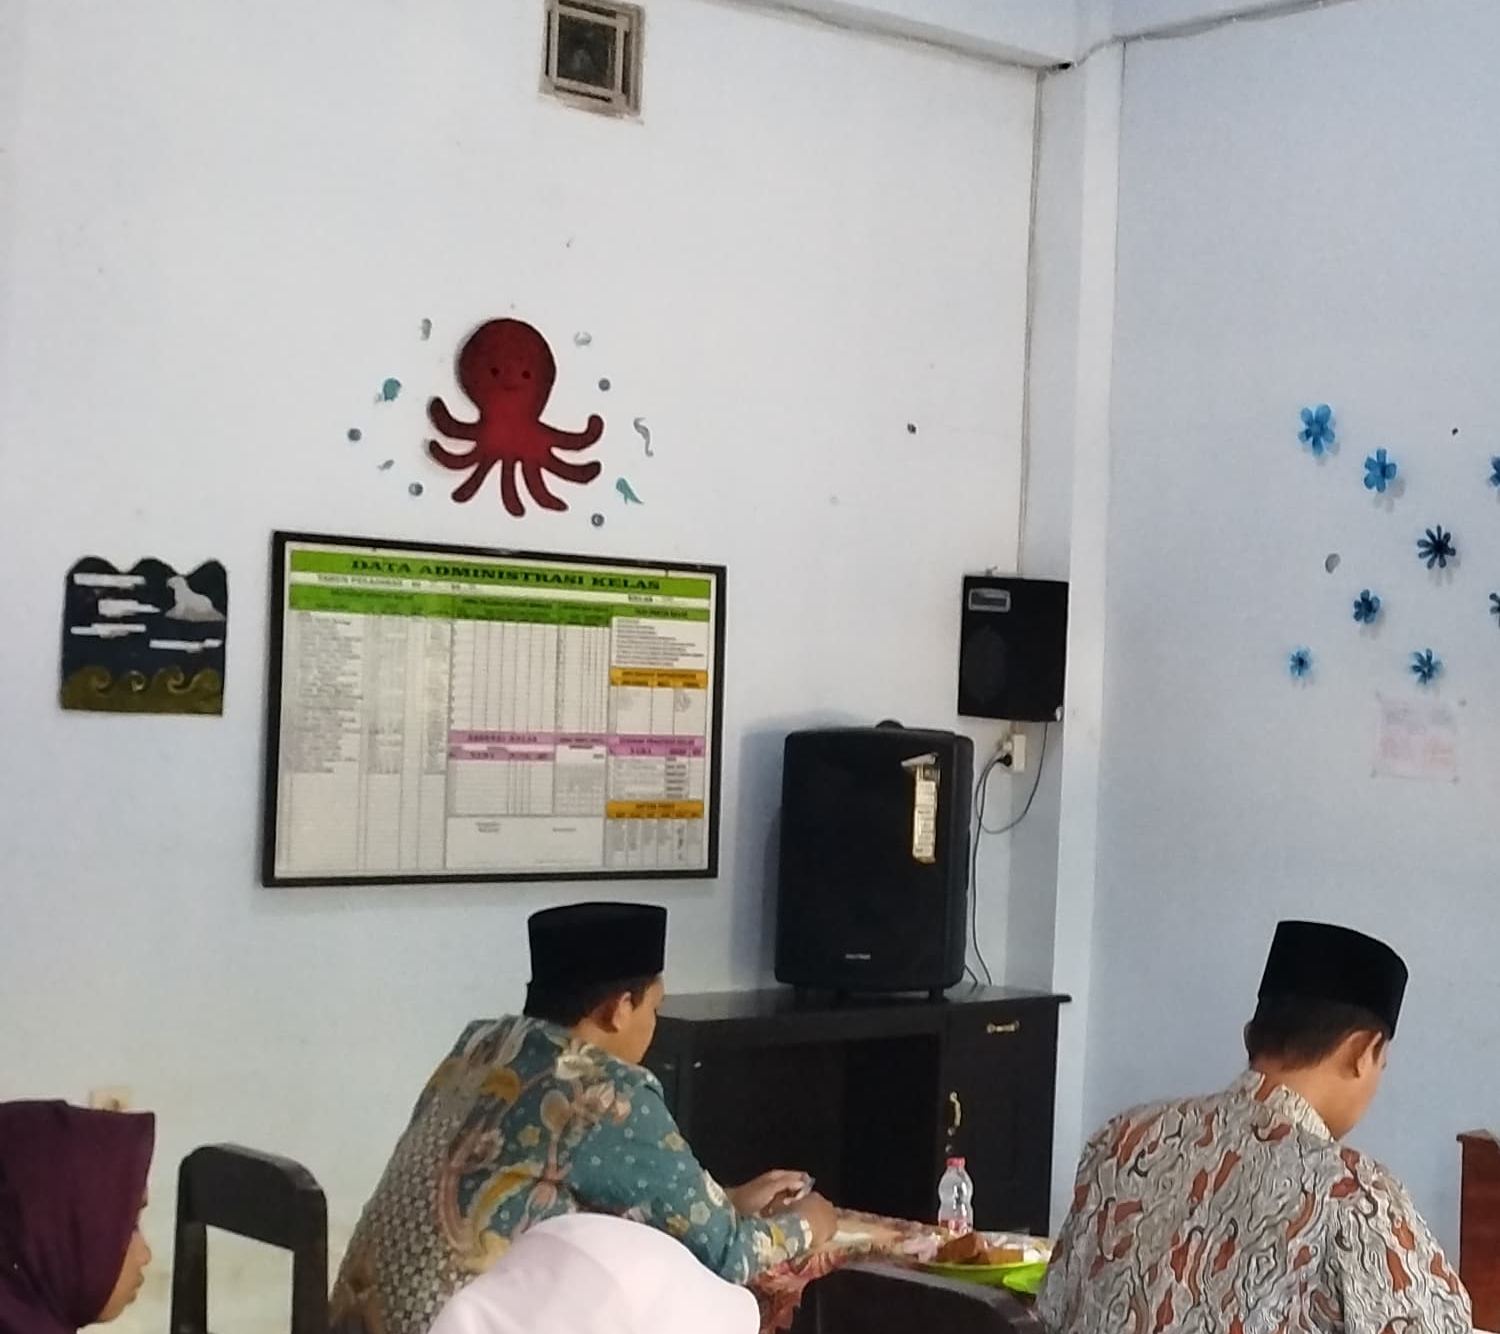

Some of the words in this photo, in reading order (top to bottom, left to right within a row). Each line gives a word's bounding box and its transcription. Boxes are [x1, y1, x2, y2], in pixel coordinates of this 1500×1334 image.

[352, 560, 411, 573] DATA
[420, 564, 584, 585] ADMINISTRASI
[591, 576, 660, 591] KELAS
